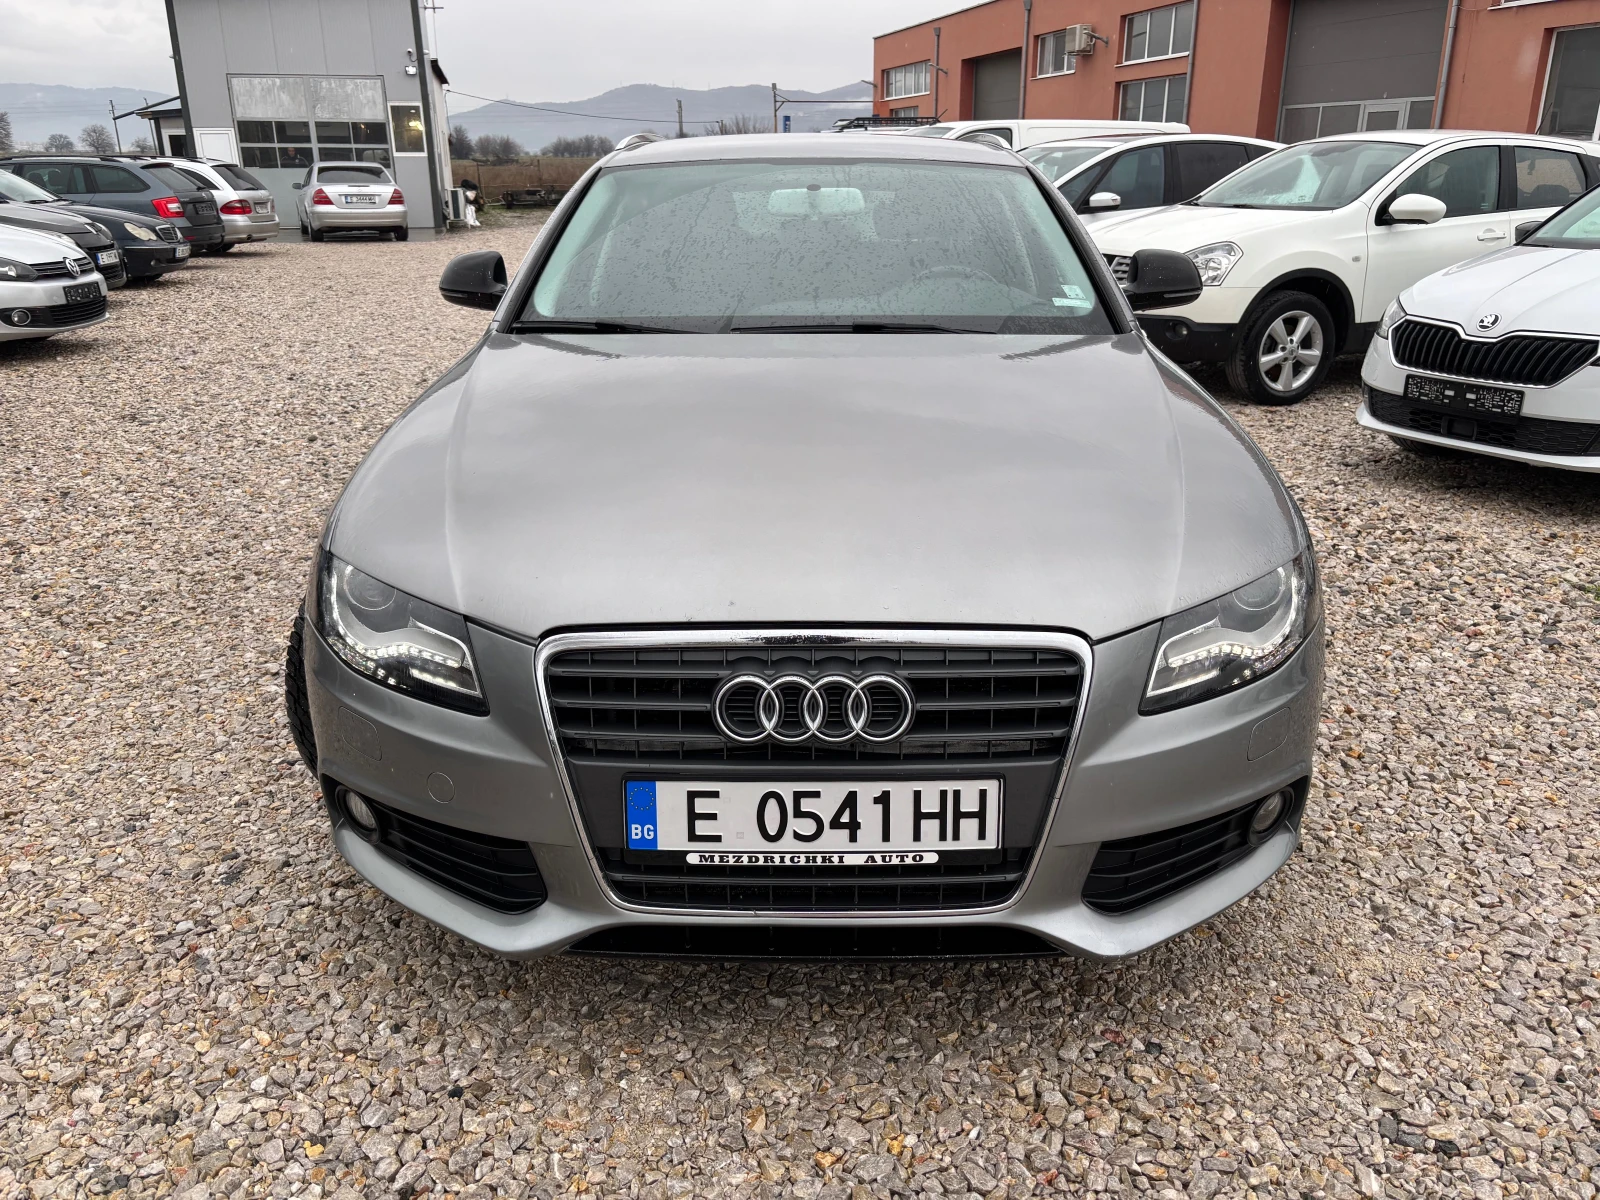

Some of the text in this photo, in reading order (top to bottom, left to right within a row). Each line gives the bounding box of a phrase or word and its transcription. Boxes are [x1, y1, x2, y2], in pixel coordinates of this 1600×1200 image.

[687, 788, 988, 843] E 0541 HH
[631, 823, 655, 840] BG
[698, 853, 925, 864] MEZDRICHKI AUTO
